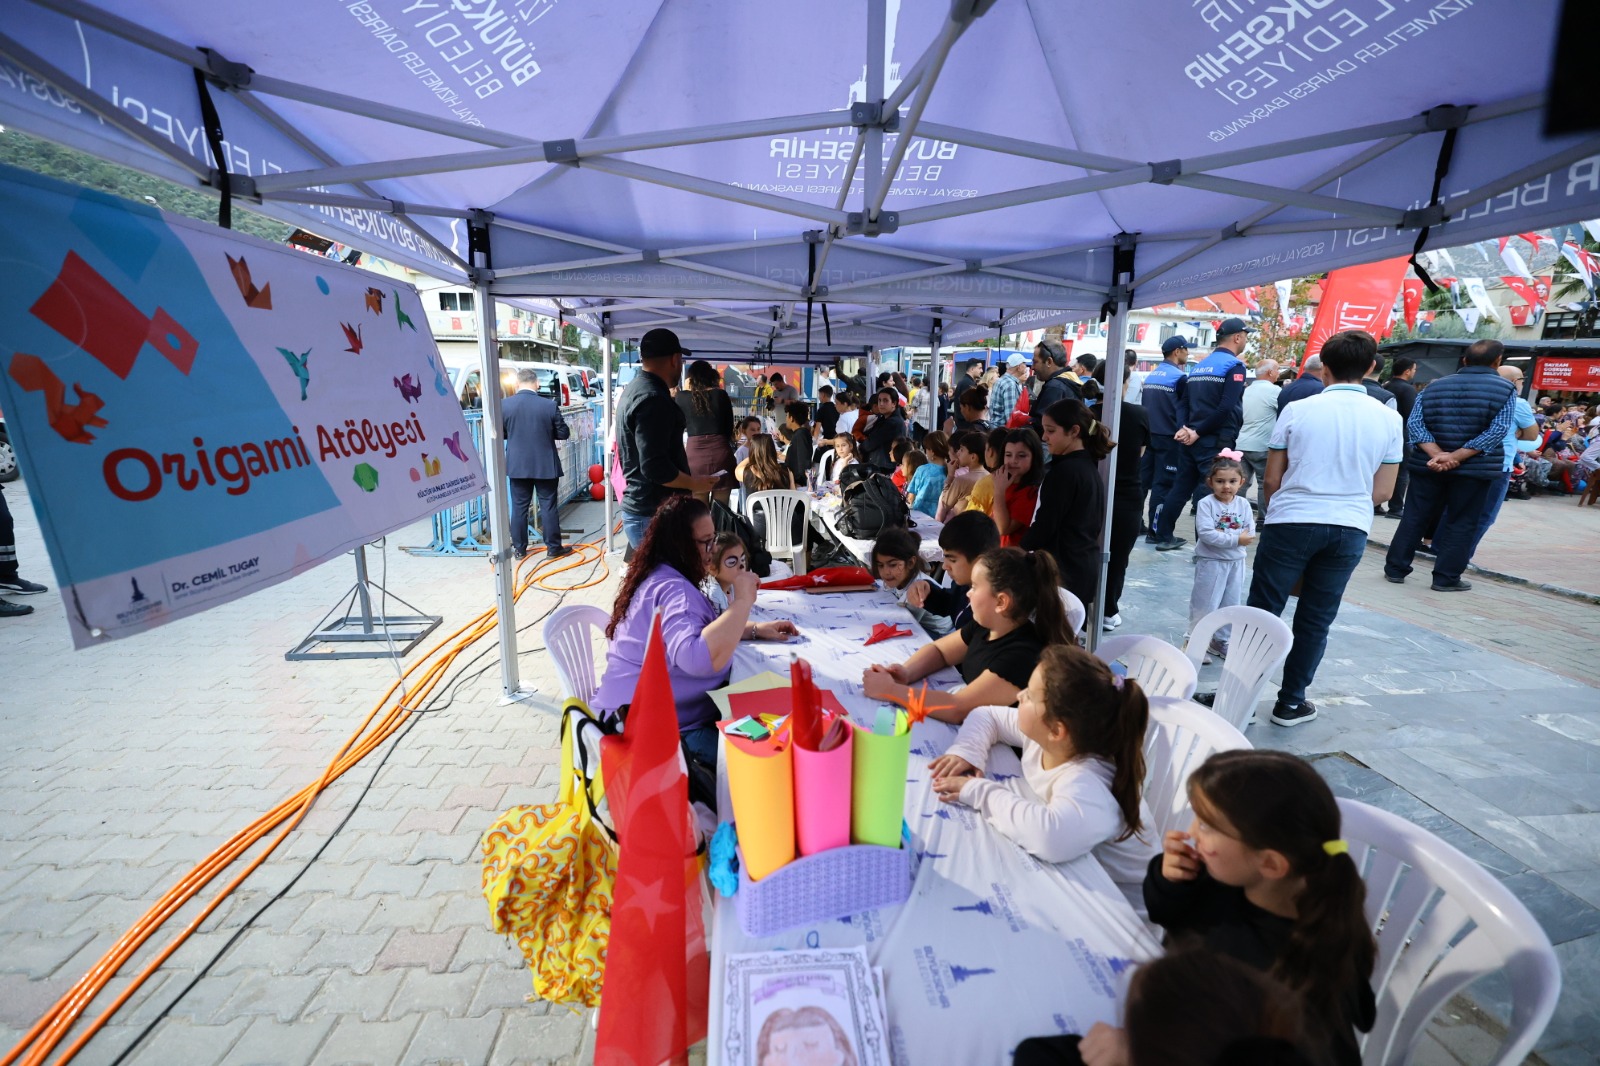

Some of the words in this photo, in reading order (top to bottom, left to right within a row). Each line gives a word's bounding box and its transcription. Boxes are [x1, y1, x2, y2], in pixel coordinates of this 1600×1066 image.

[103, 426, 310, 502] Origami
[316, 412, 426, 462] Atölyesi
[172, 582, 190, 593] Dr.
[192, 567, 227, 586] CEMİL
[228, 556, 260, 575] TUGAY
